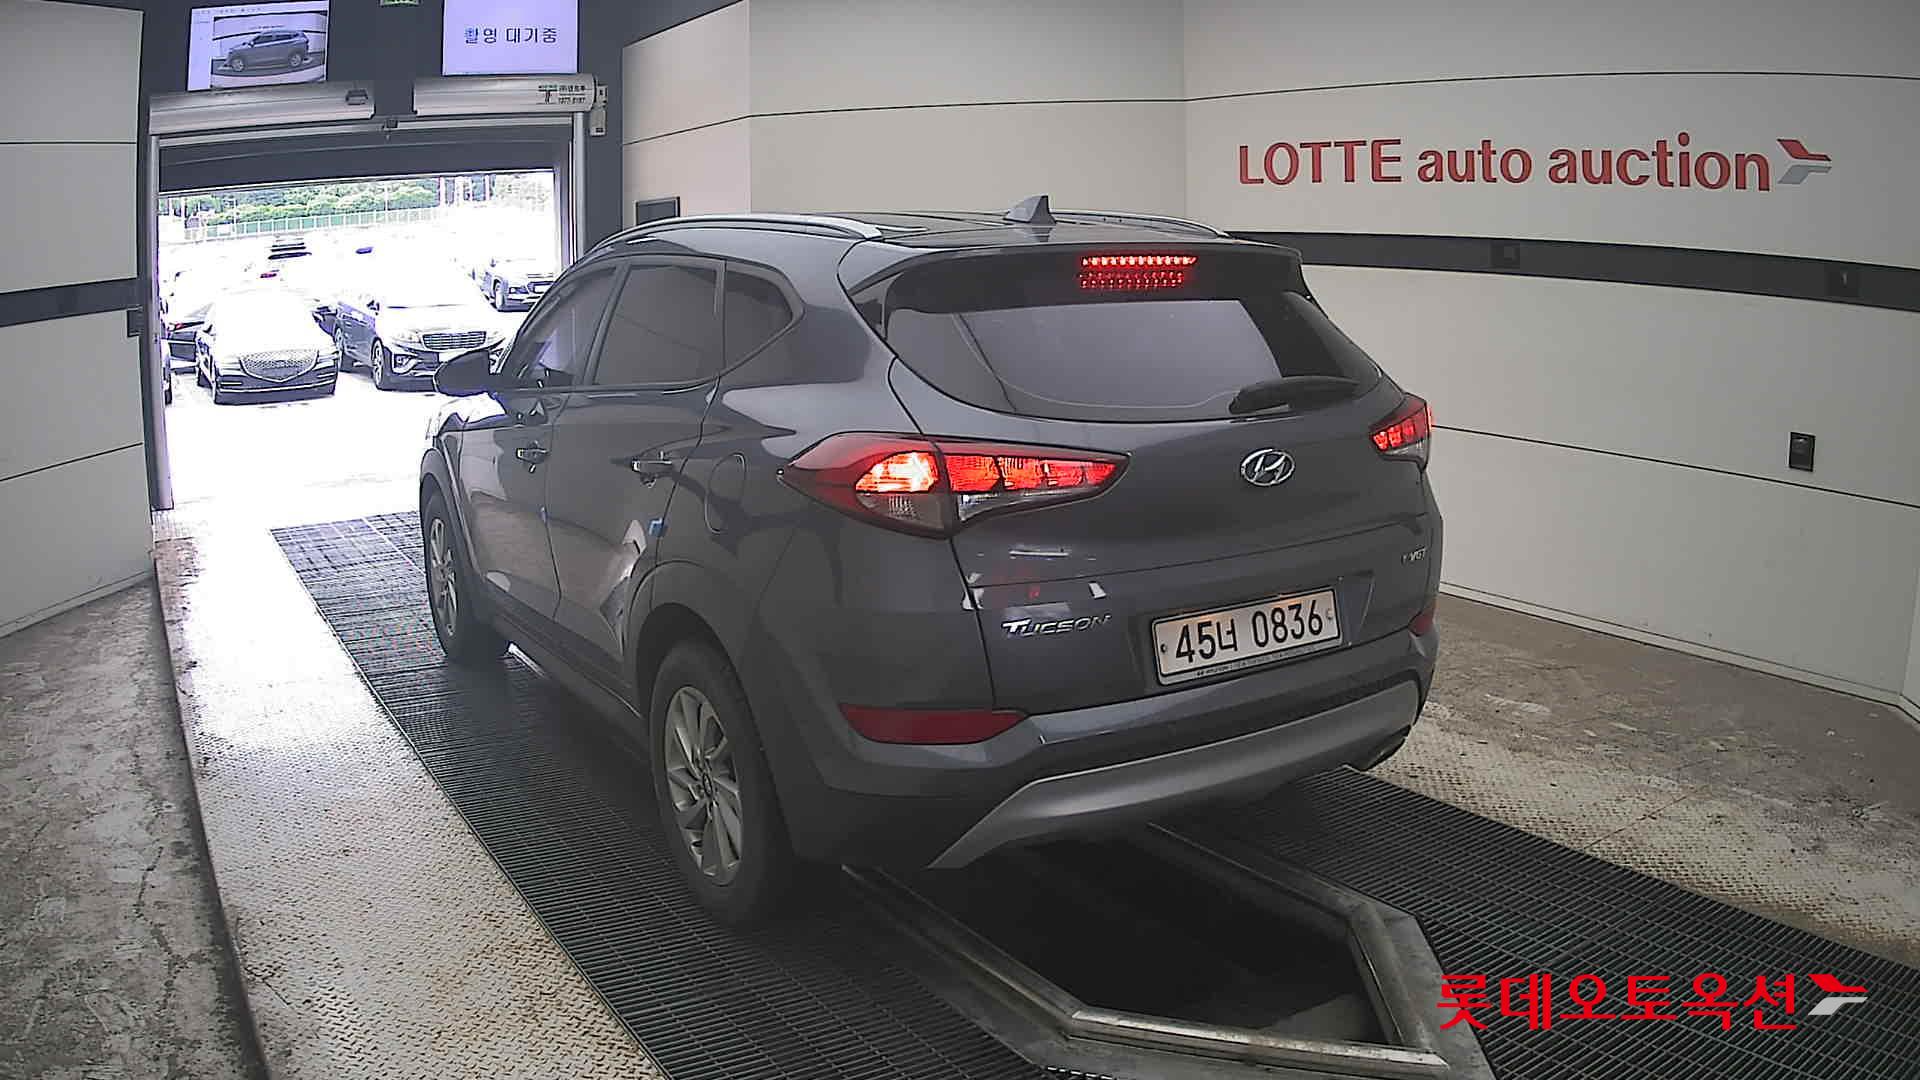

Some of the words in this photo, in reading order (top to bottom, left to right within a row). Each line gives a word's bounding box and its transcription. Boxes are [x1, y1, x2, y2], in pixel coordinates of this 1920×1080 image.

[506, 27, 557, 44] 대기중
[1239, 138, 1402, 186] LOTTE
[1417, 139, 1533, 184] auto
[1548, 132, 1771, 192] auction
[1001, 612, 1112, 637] TUCSON
[1175, 618, 1238, 663] 45너
[1252, 599, 1323, 648] 0836
